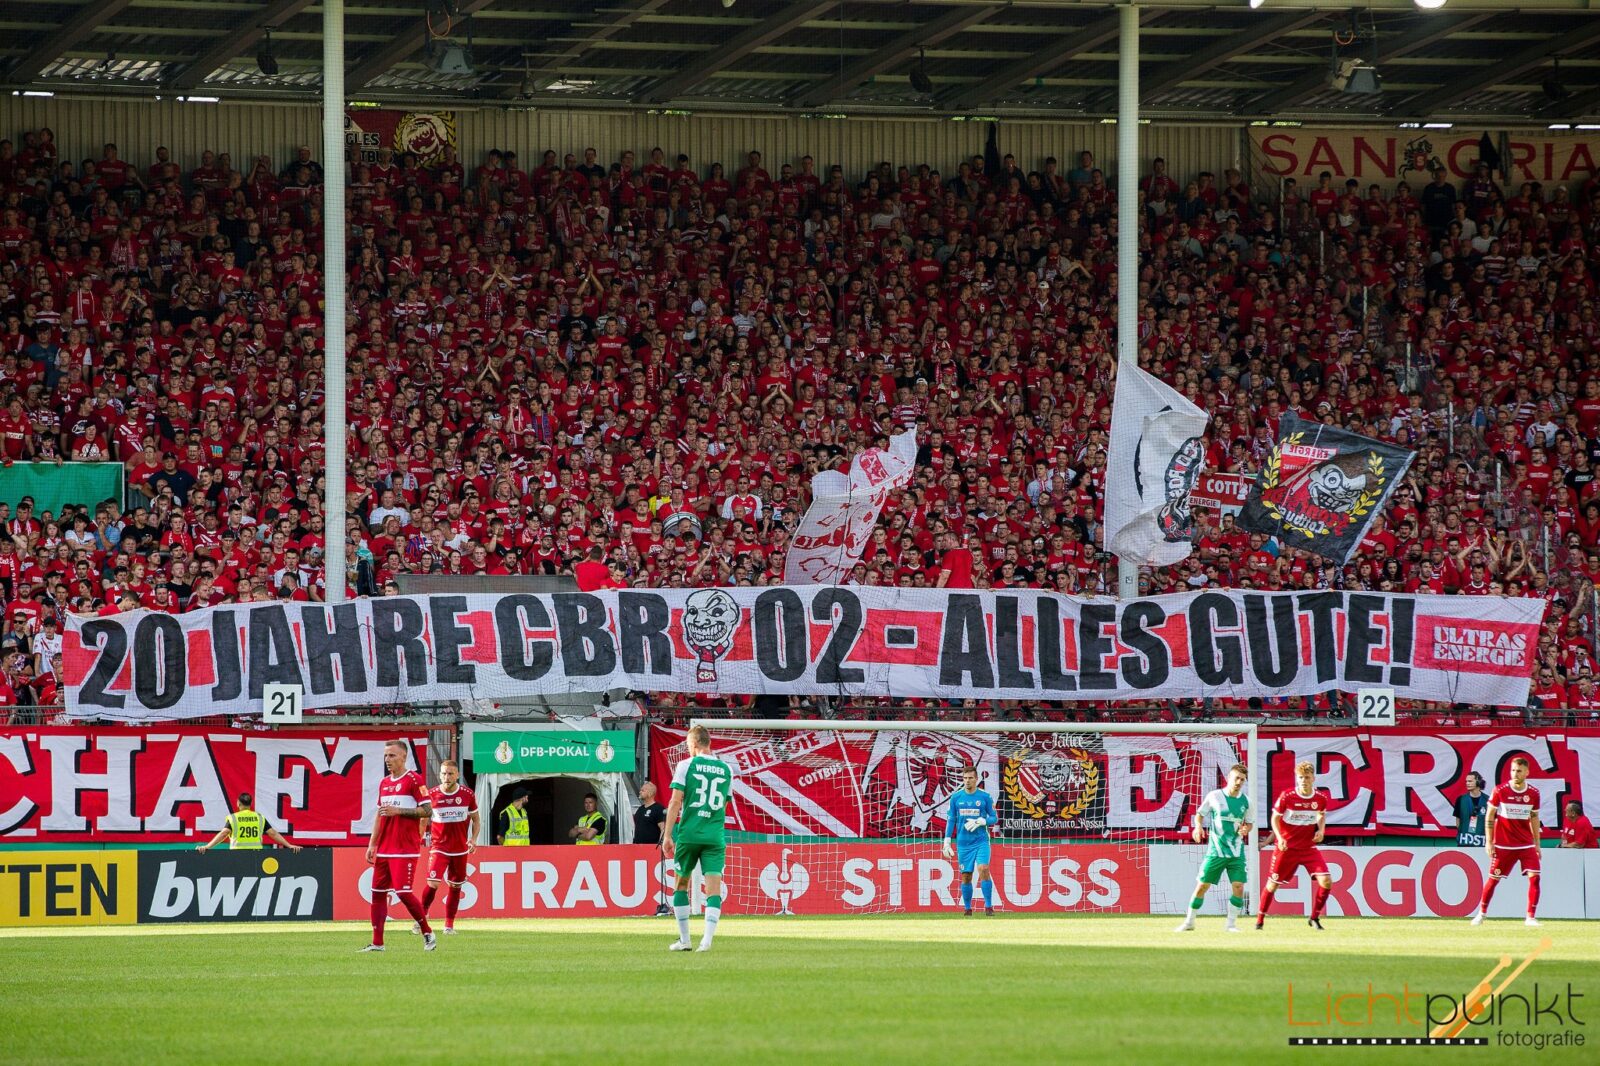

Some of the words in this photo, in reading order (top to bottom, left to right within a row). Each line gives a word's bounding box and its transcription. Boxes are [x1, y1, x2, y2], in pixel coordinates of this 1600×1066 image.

[1261, 134, 1398, 179] SAN
[1189, 497, 1217, 507] ENERGIE
[78, 613, 187, 709] 20
[211, 596, 477, 701] JAHRE
[494, 592, 672, 681] CBR
[754, 587, 865, 684] 02
[939, 593, 1169, 692] ALLES
[1188, 591, 1415, 688] GUTE!
[1434, 626, 1526, 650] ULTRAS
[1433, 643, 1526, 667] ENERGIE
[271, 691, 296, 716] 21
[1362, 694, 1391, 719] 22
[520, 746, 590, 758] DFB-POKAL
[695, 764, 725, 776] WERDER
[798, 762, 844, 788] COTTBUS
[688, 773, 727, 811] 36
[239, 826, 259, 838] 296
[0, 862, 118, 918] TEN
[149, 856, 319, 918] bwin
